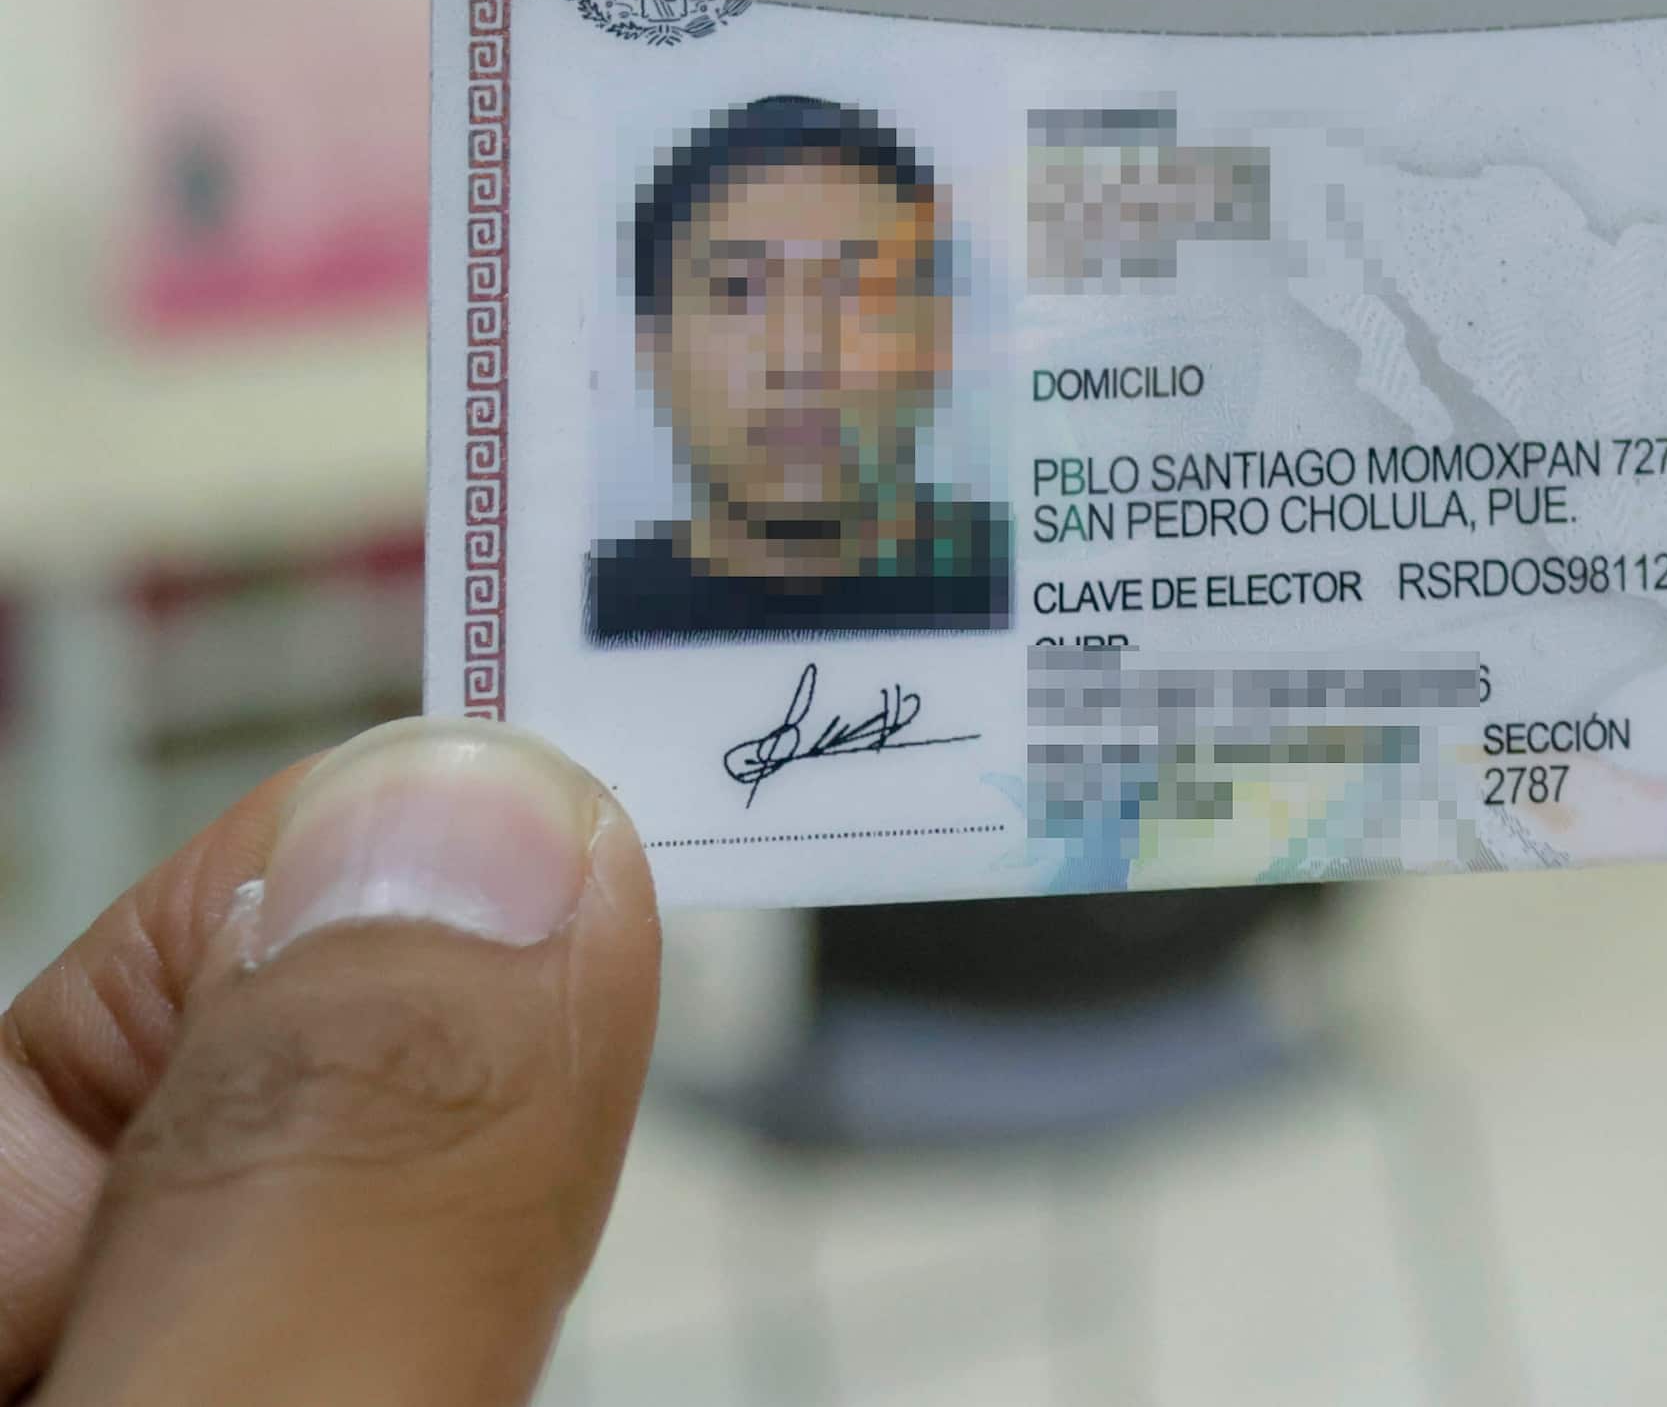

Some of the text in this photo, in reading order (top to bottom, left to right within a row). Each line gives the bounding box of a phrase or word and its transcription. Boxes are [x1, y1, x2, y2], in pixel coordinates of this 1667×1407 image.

[1032, 364, 1205, 402] DOMICILIO
[1033, 455, 1140, 497] PBLO
[1151, 448, 1356, 493] SANTIAGO
[1367, 439, 1601, 486] MOMOXPAN
[1033, 485, 1578, 544] SAN PEDRO CHOLULA, PUE.
[1033, 578, 1143, 615] CLAVE
[1151, 577, 1198, 610] DE
[1206, 569, 1363, 608] ELECTOR
[1482, 711, 1632, 756] SECCIÓN
[1483, 764, 1571, 806] 2787
